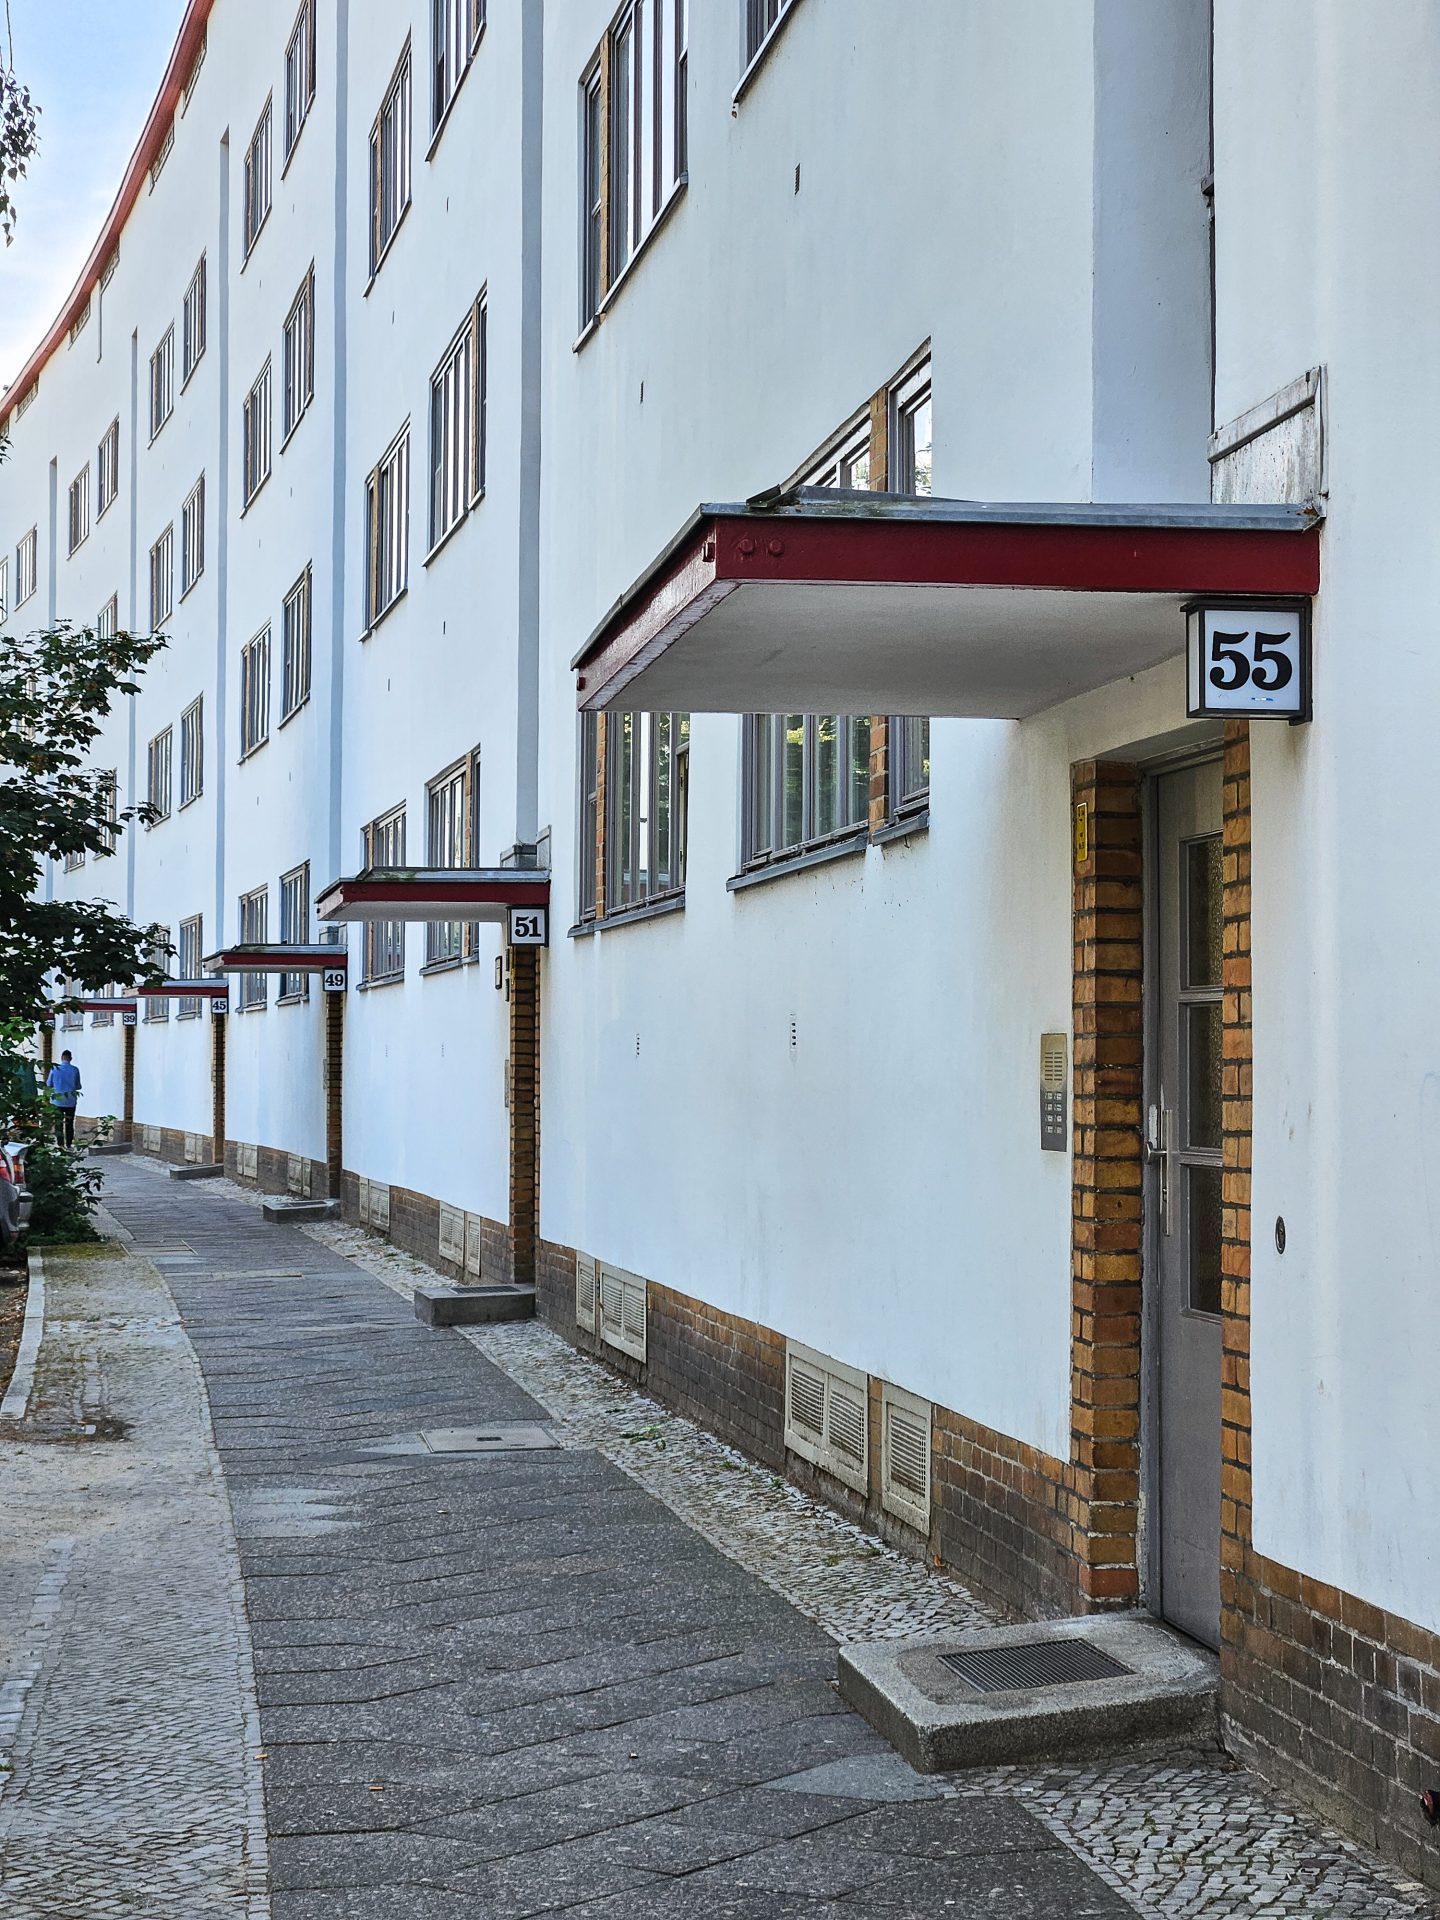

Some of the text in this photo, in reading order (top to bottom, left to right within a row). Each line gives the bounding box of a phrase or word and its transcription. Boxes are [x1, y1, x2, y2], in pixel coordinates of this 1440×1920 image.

[1209, 630, 1293, 691] 55
[514, 916, 542, 938] 51
[325, 973, 345, 987] 49
[212, 1000, 227, 1011] 45
